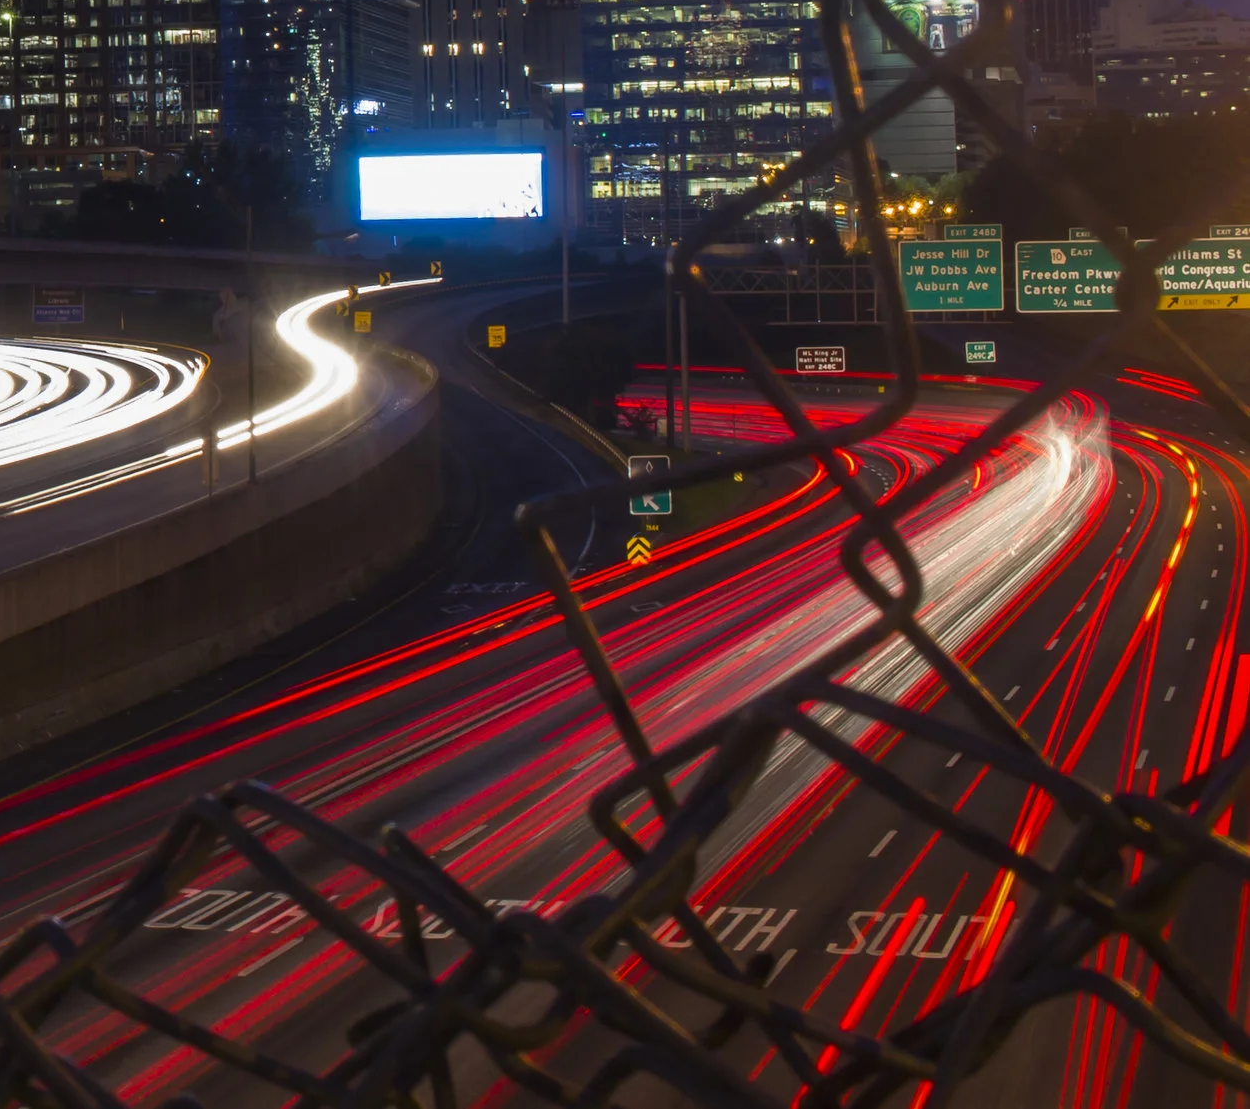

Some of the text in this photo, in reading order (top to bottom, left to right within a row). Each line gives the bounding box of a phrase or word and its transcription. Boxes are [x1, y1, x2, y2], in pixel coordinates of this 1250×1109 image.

[972, 228, 997, 237] 248D
[1234, 228, 1250, 236] 24
[912, 248, 990, 260] Jesse Hill Dr
[1052, 252, 1063, 261] 10
[1070, 248, 1093, 256] EAST
[1169, 249, 1242, 260] illiams St
[906, 264, 997, 276] JW Dobbs Ave
[1022, 270, 1080, 280] Freedom
[1181, 264, 1236, 277] Congress
[915, 280, 989, 291] Auburn Ave
[1024, 284, 1115, 295] Carter Cente
[947, 296, 964, 304] MILE
